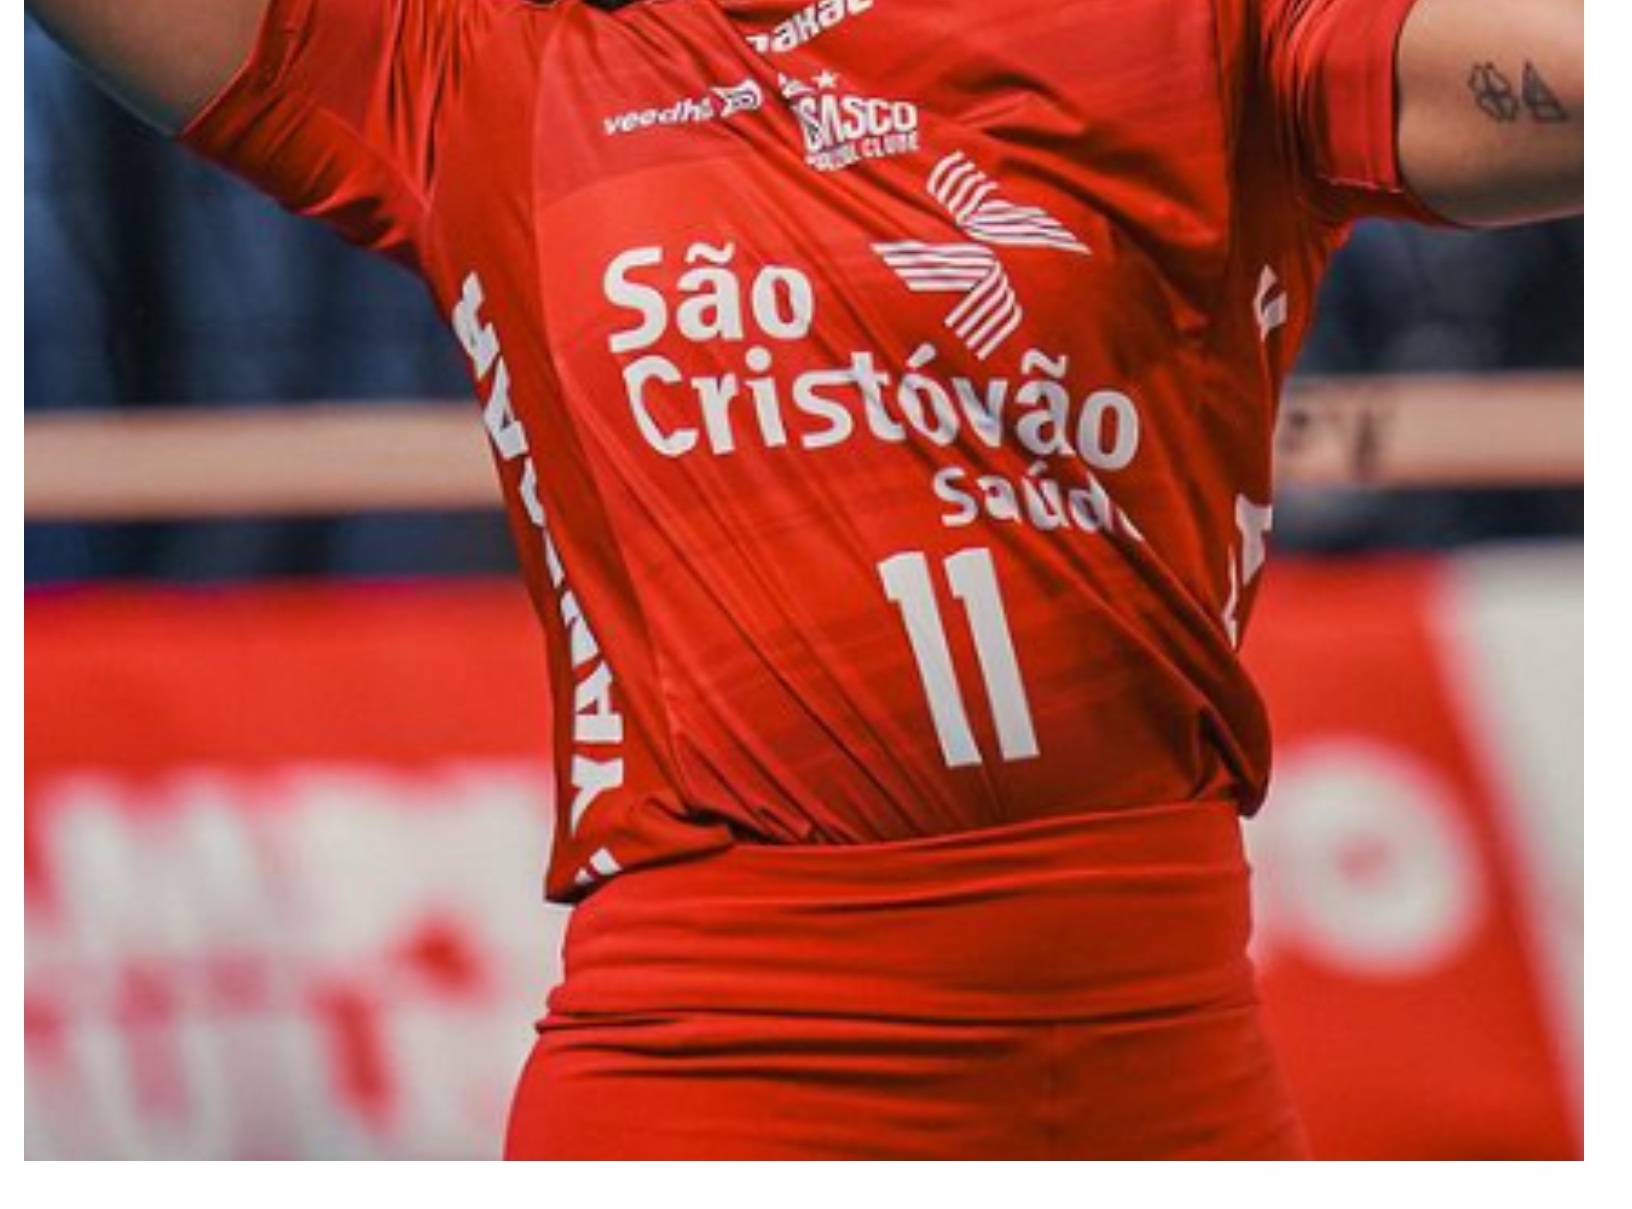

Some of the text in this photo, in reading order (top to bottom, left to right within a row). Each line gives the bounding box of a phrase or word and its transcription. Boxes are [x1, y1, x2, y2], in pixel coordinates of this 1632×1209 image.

[602, 241, 816, 354] São
[622, 343, 1141, 472] Cristóvão
[932, 462, 1145, 541] Saúd
[876, 547, 1042, 769] 11
